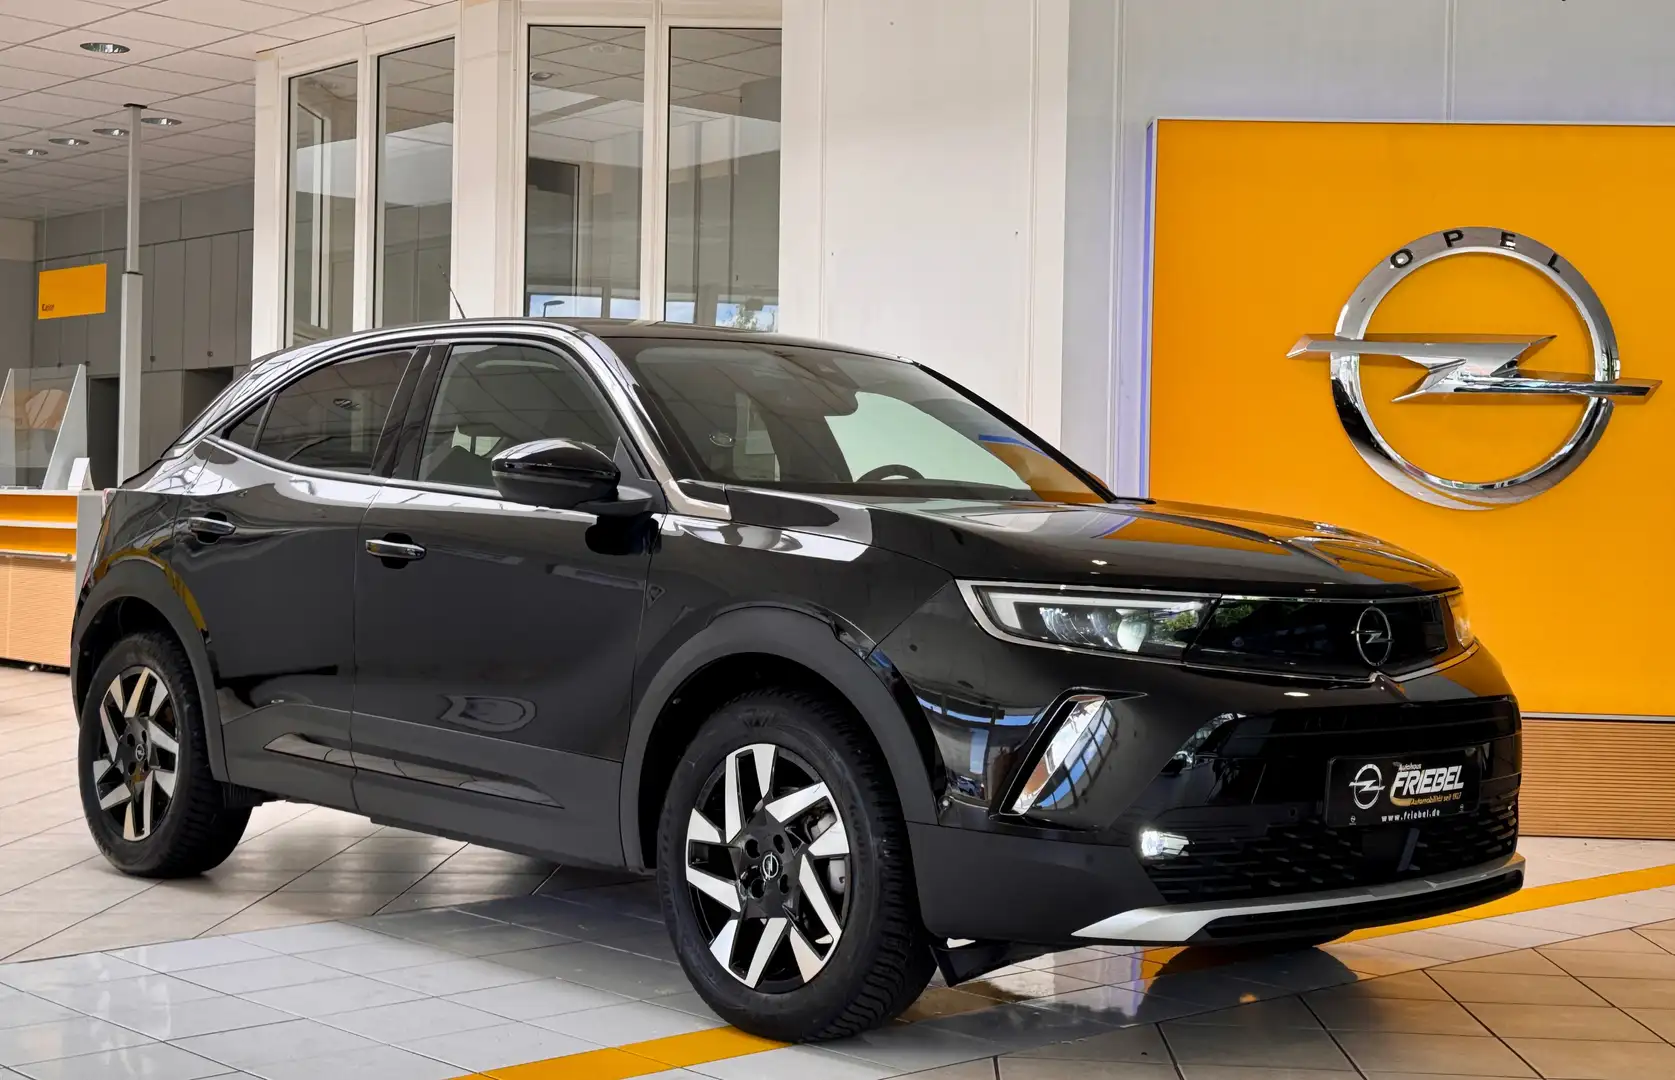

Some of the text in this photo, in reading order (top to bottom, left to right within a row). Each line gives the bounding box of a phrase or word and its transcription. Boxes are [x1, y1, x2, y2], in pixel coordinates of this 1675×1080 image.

[1390, 229, 1561, 274] OPEL
[1390, 765, 1464, 800] FRIEBEL
[1381, 808, 1440, 822] www.friebel.de
